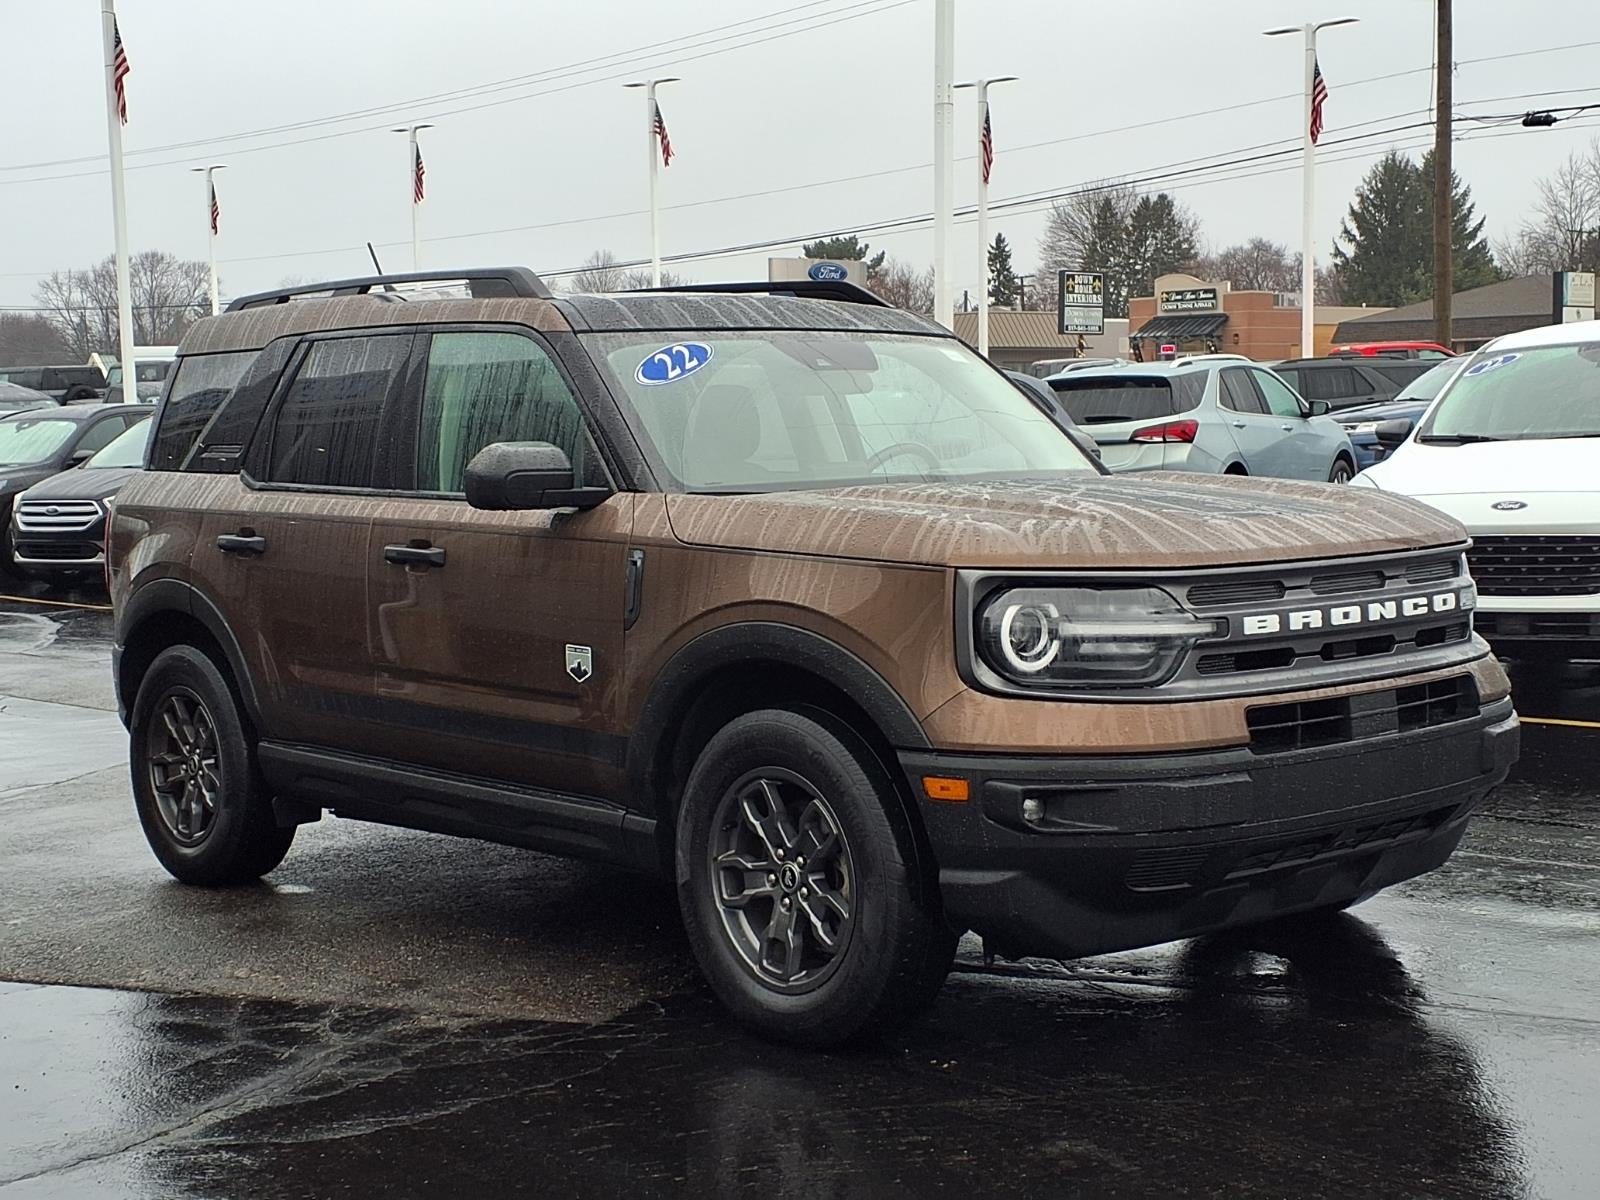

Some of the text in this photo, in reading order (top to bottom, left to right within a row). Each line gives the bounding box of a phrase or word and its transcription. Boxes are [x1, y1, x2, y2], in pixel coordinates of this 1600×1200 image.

[818, 266, 841, 279] Ford
[1074, 274, 1094, 284] DOWN
[1074, 284, 1093, 294] HOME
[1066, 293, 1102, 303] INTERIORS
[654, 345, 699, 379] 22
[1497, 501, 1520, 509] Ford
[1243, 592, 1456, 636] BRONCO
